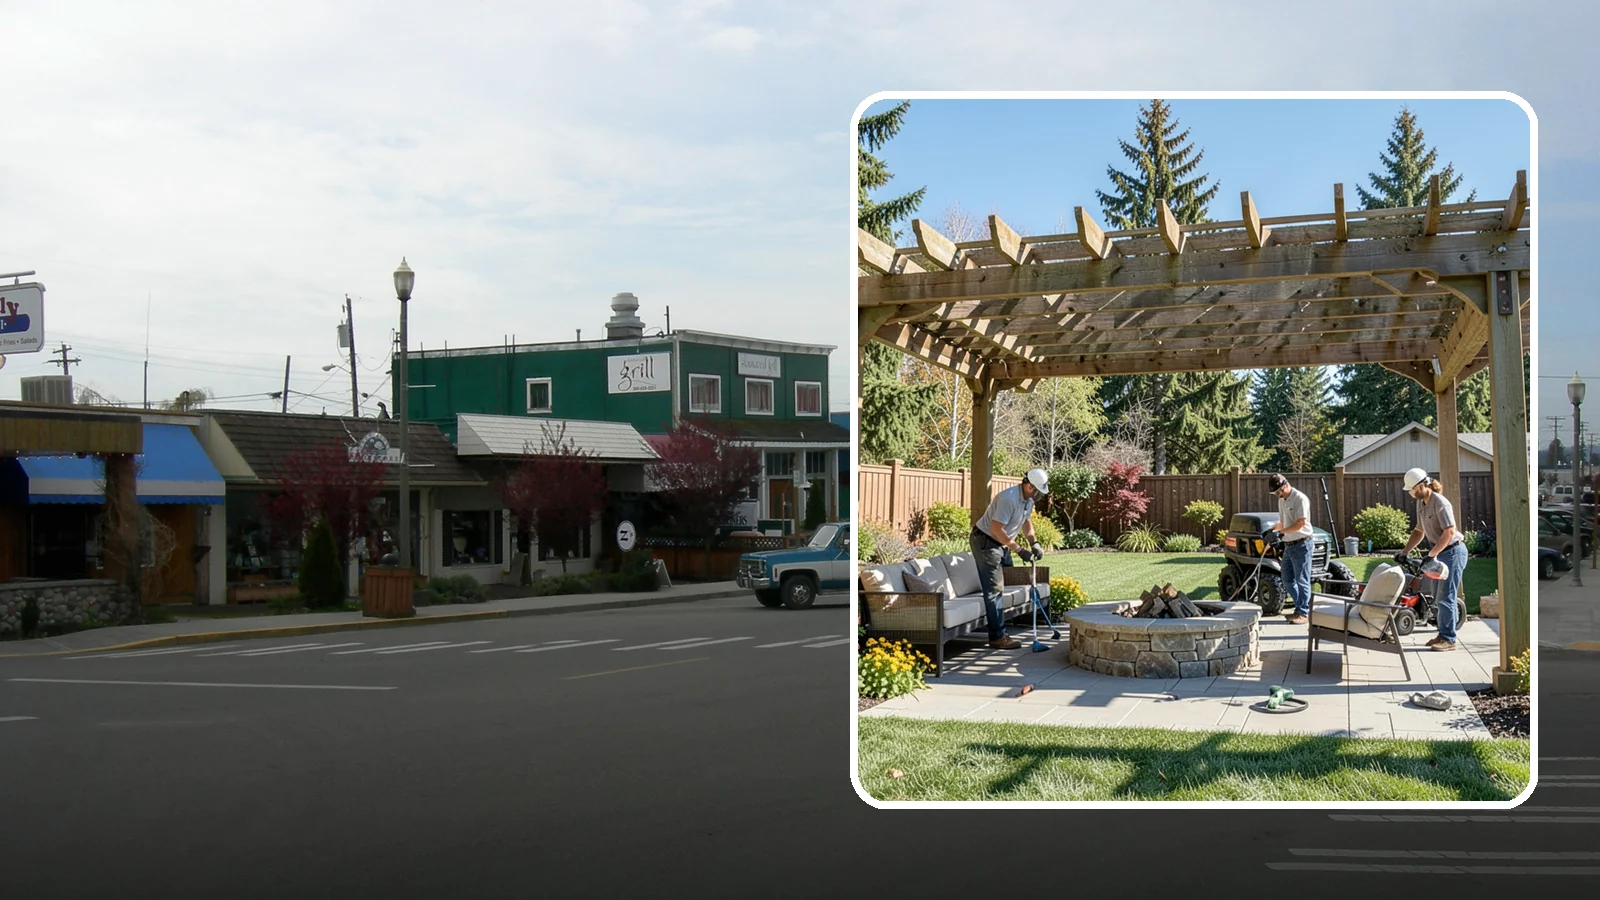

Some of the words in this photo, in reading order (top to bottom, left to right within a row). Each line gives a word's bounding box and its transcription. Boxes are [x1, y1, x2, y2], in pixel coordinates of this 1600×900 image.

[3, 338, 16, 346] Fries
[20, 337, 38, 345] Salads
[618, 356, 654, 391] grill
